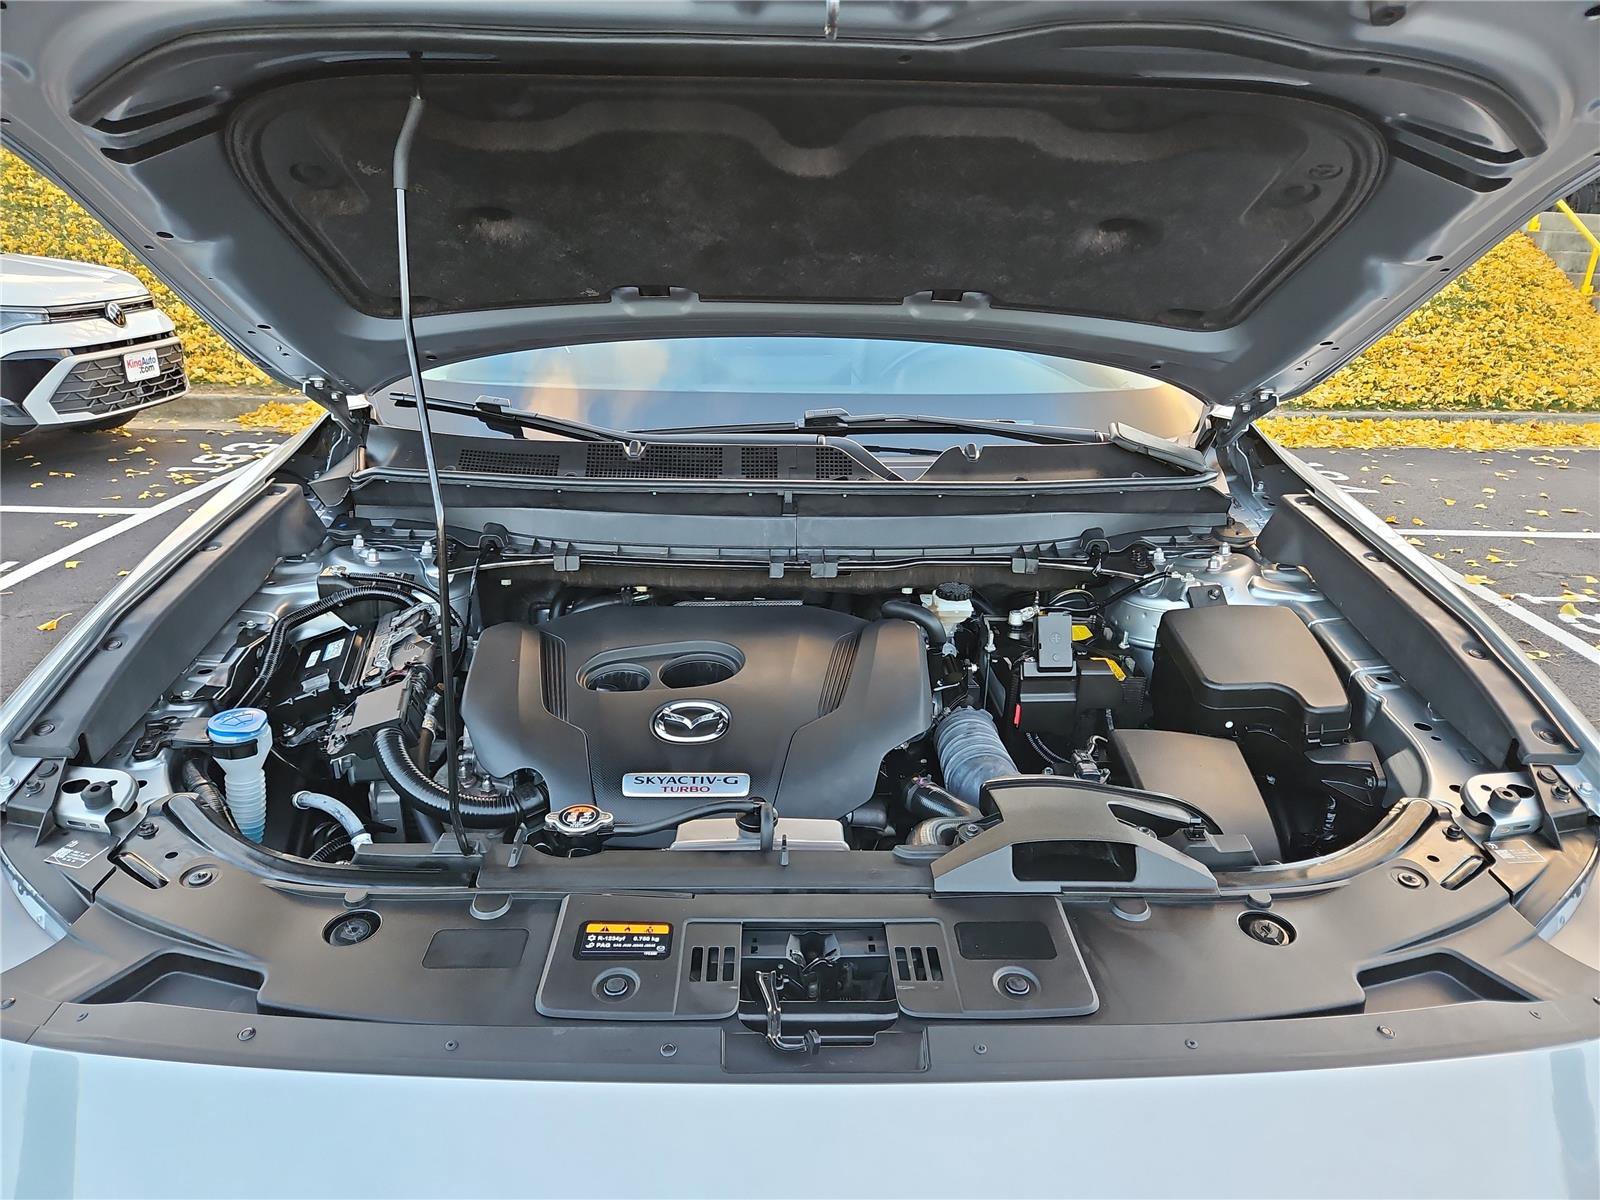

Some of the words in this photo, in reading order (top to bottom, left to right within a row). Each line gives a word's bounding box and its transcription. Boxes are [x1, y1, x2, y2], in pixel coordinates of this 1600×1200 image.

[127, 356, 156, 369] KingAuto
[139, 365, 155, 374] .com
[633, 776, 738, 785] SKYACTIV-G
